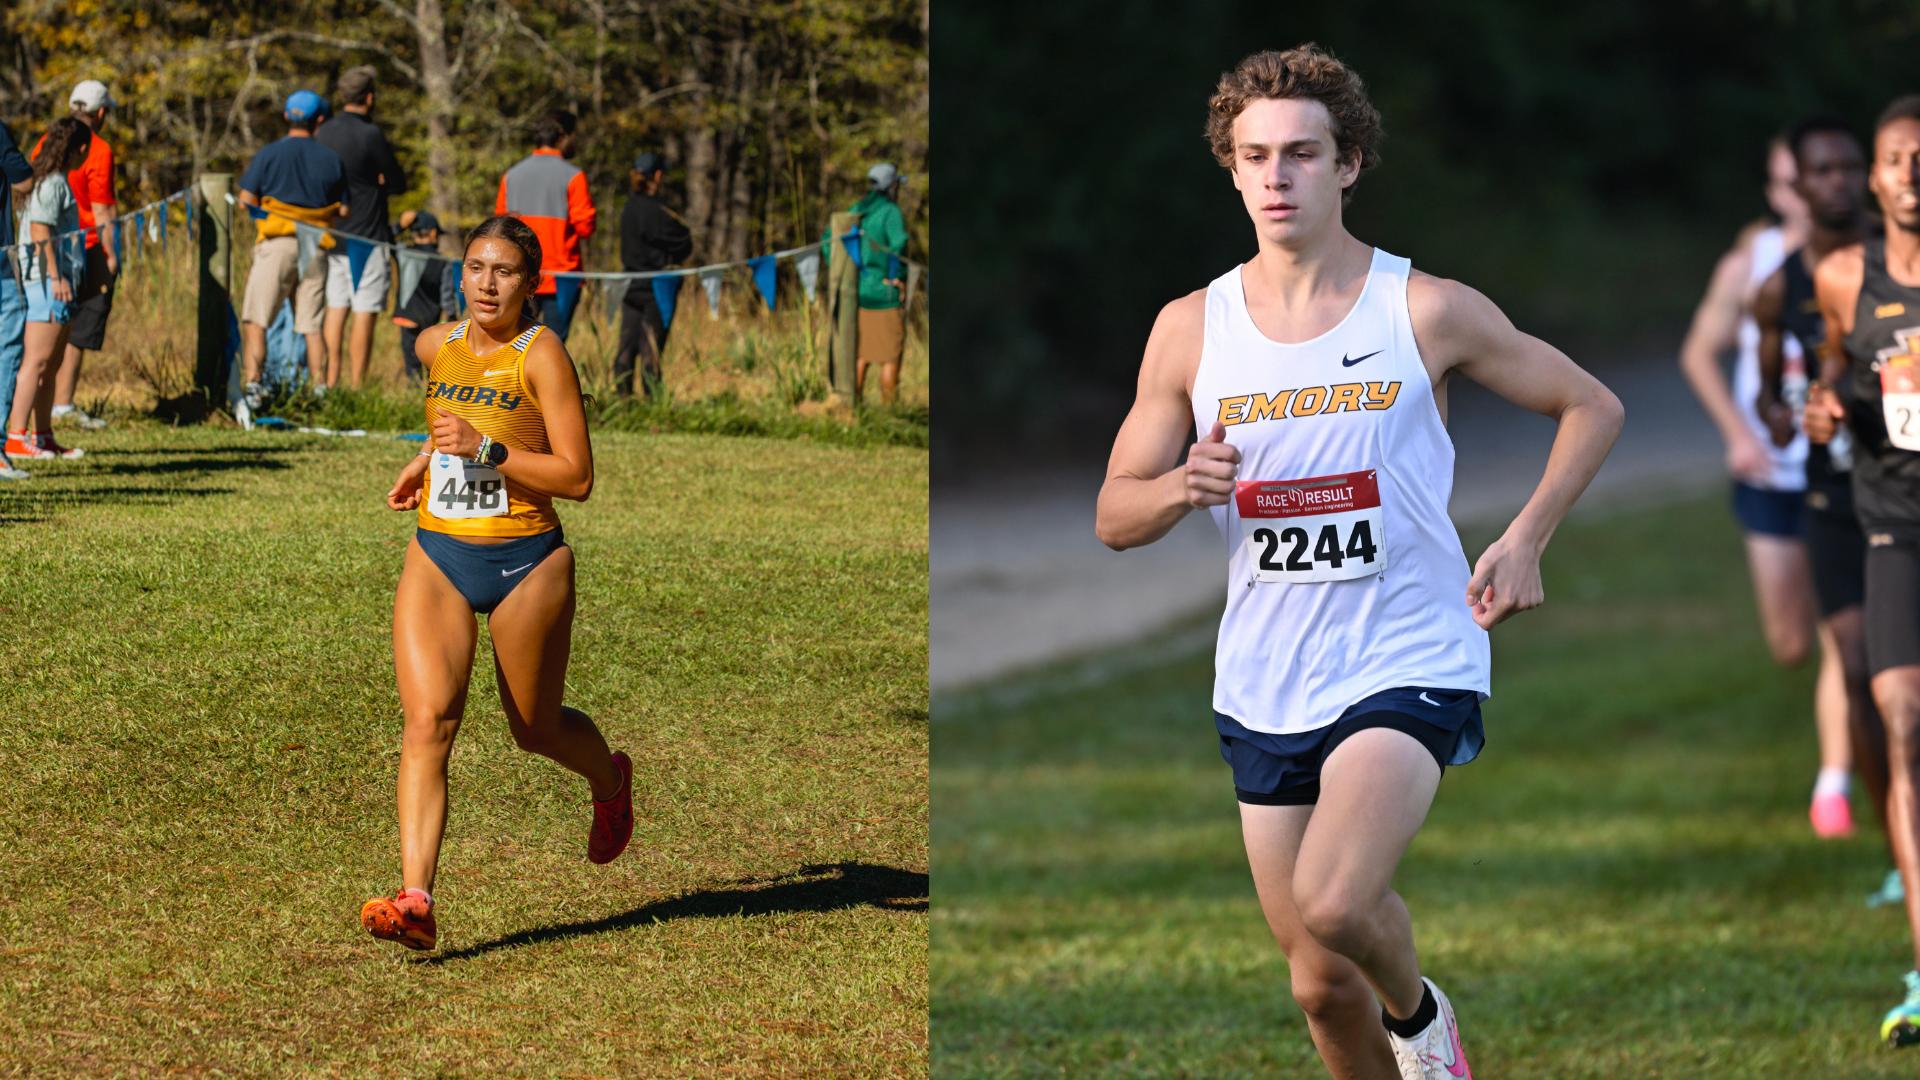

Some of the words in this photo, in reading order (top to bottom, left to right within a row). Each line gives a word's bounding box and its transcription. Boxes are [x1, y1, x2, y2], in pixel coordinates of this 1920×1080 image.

[426, 382, 521, 411] EMORY
[1217, 381, 1402, 427] EMORY
[437, 477, 501, 510] 448
[1257, 494, 1289, 507] RACE
[1305, 487, 1354, 504] RESULT
[1253, 519, 1377, 571] 2244
